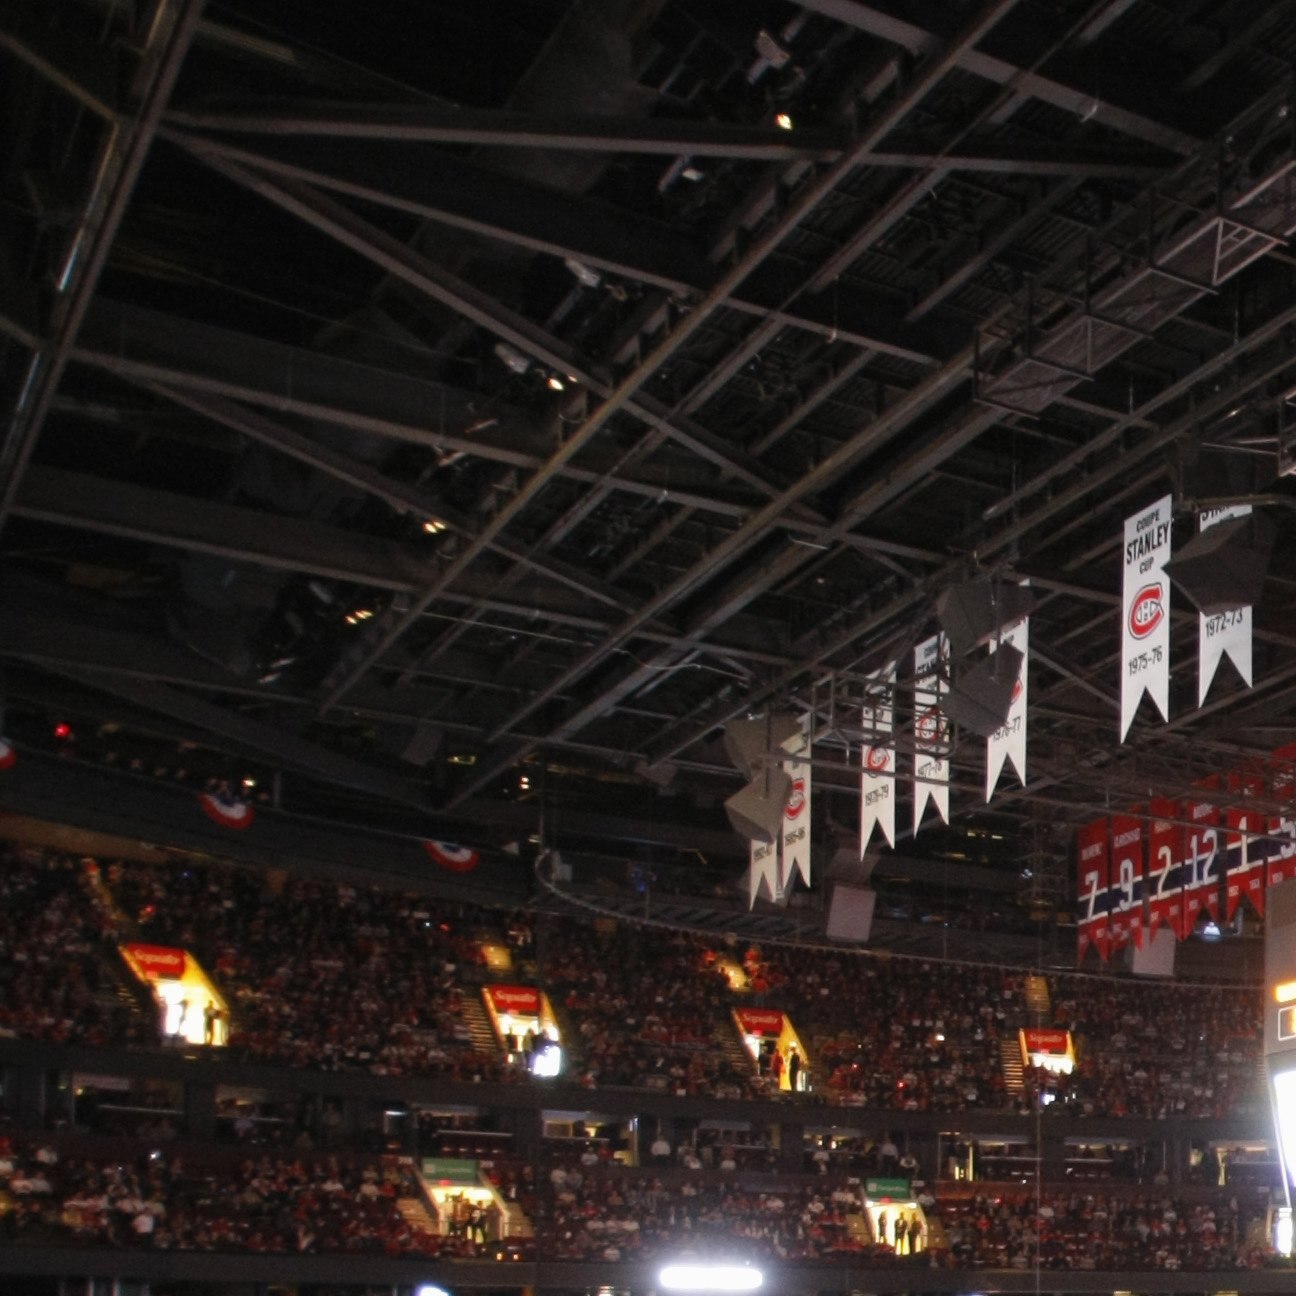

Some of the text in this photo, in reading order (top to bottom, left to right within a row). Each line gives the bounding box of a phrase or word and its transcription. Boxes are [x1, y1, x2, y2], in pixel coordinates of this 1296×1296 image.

[1126, 521, 1170, 566] STANLEY
[1136, 508, 1161, 534] COUPE
[1139, 556, 1155, 575] CUP
[1128, 645, 1164, 677] 1975-76
[1157, 845, 1173, 900] 2
[1190, 828, 1220, 890] 12
[1119, 858, 1134, 912] 9
